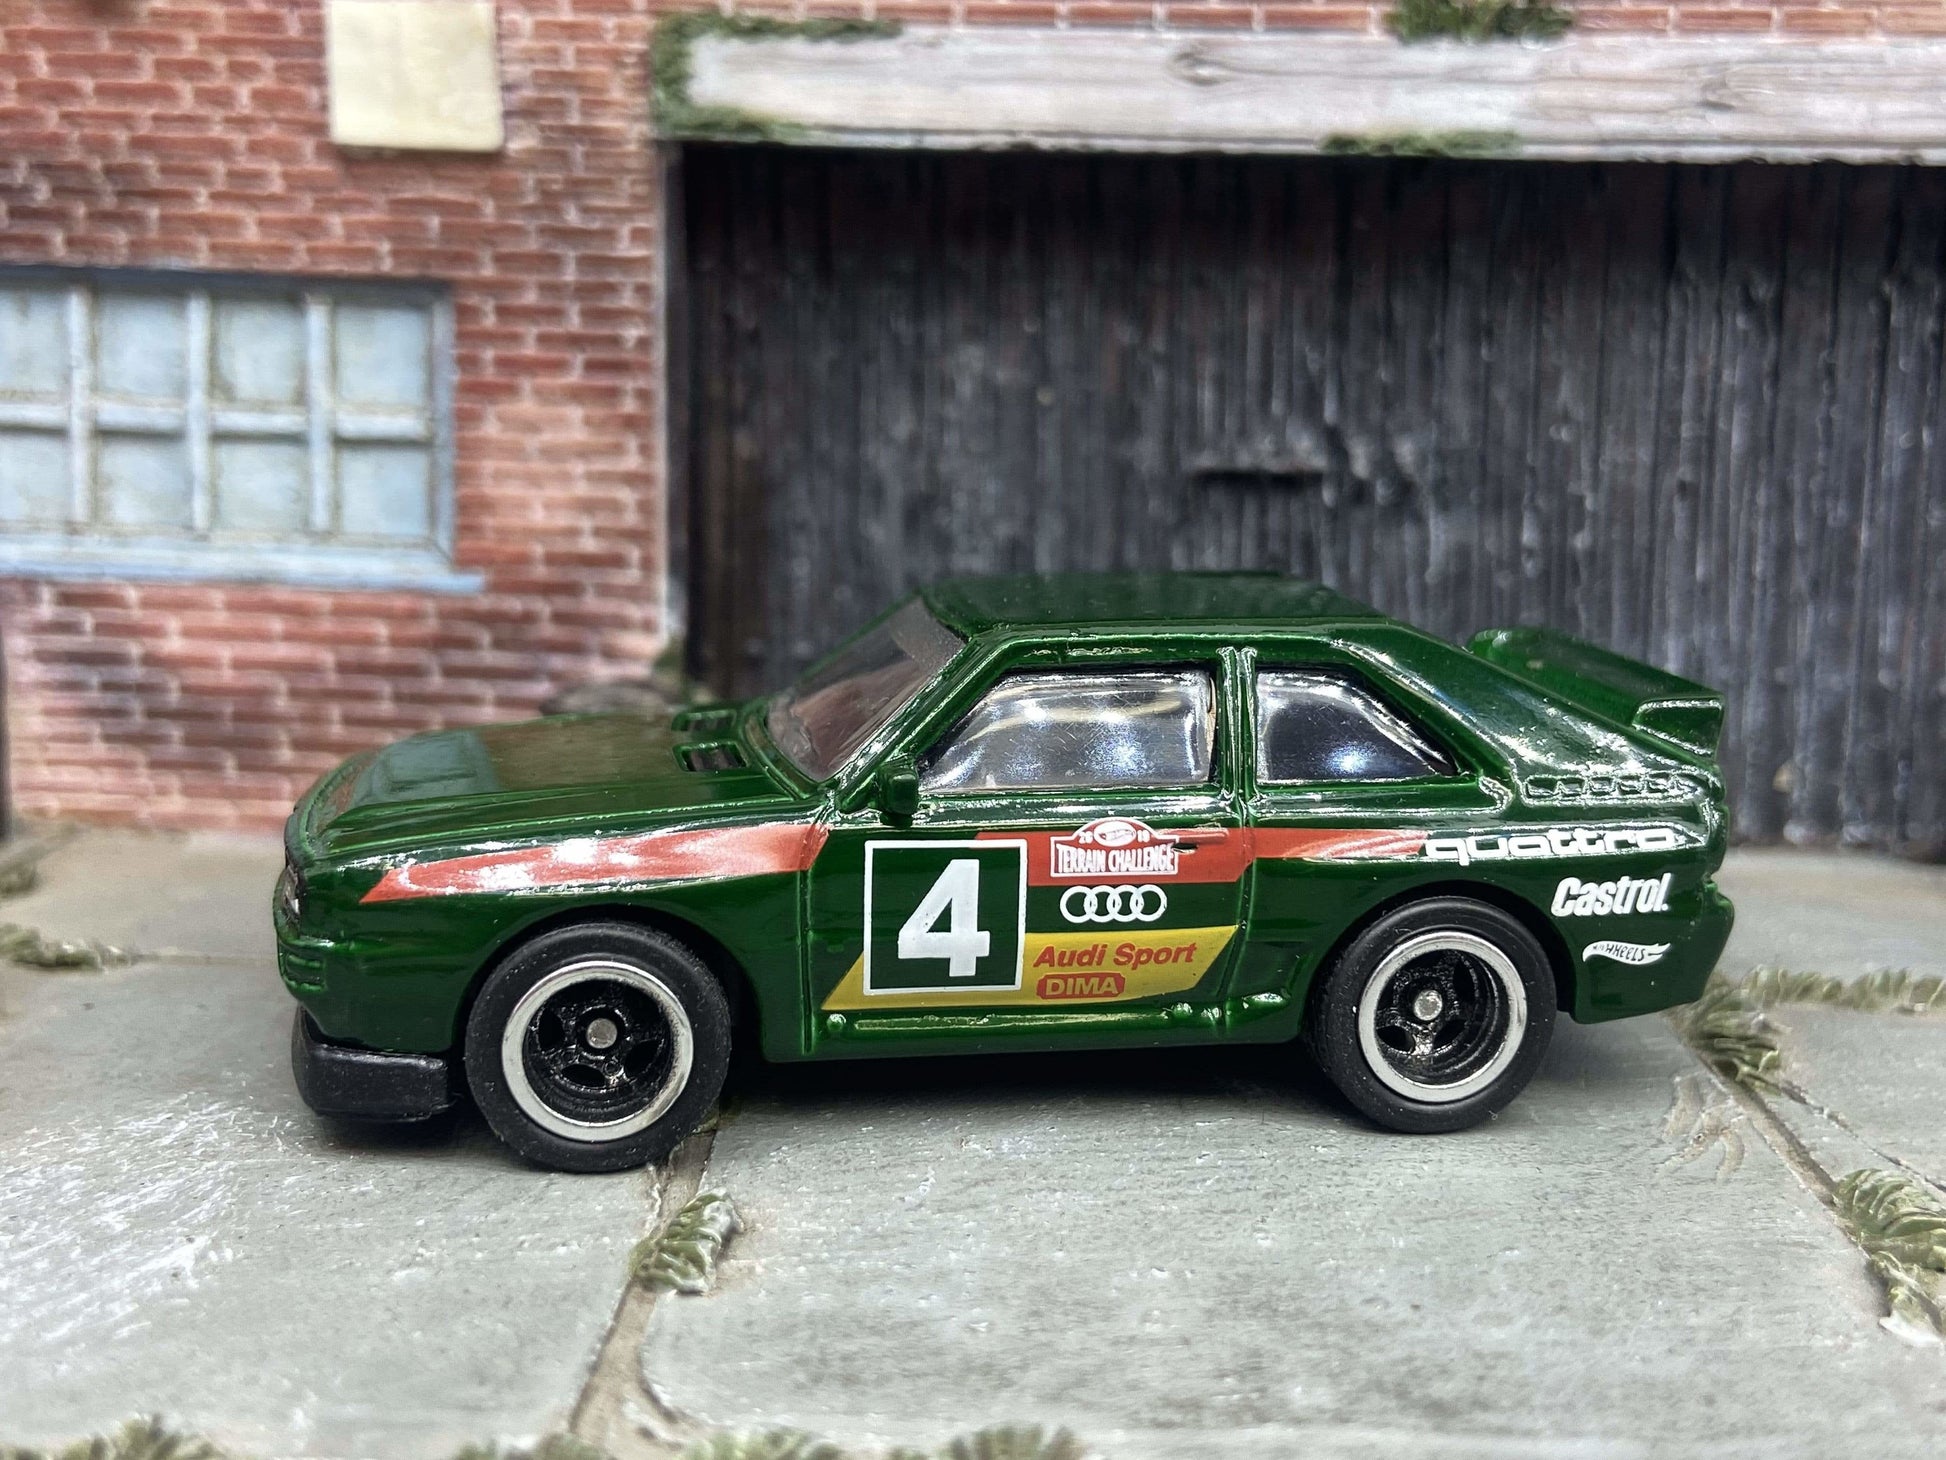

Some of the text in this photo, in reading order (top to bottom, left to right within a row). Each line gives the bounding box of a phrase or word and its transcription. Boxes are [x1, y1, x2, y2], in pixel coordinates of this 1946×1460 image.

[1056, 842, 1174, 873] TERRAIN CHALLENGE
[1425, 829, 1675, 866] quattro
[898, 859, 991, 977] 4
[1033, 942, 1197, 970] Audi Sport
[1045, 978, 1118, 996] DIMA
